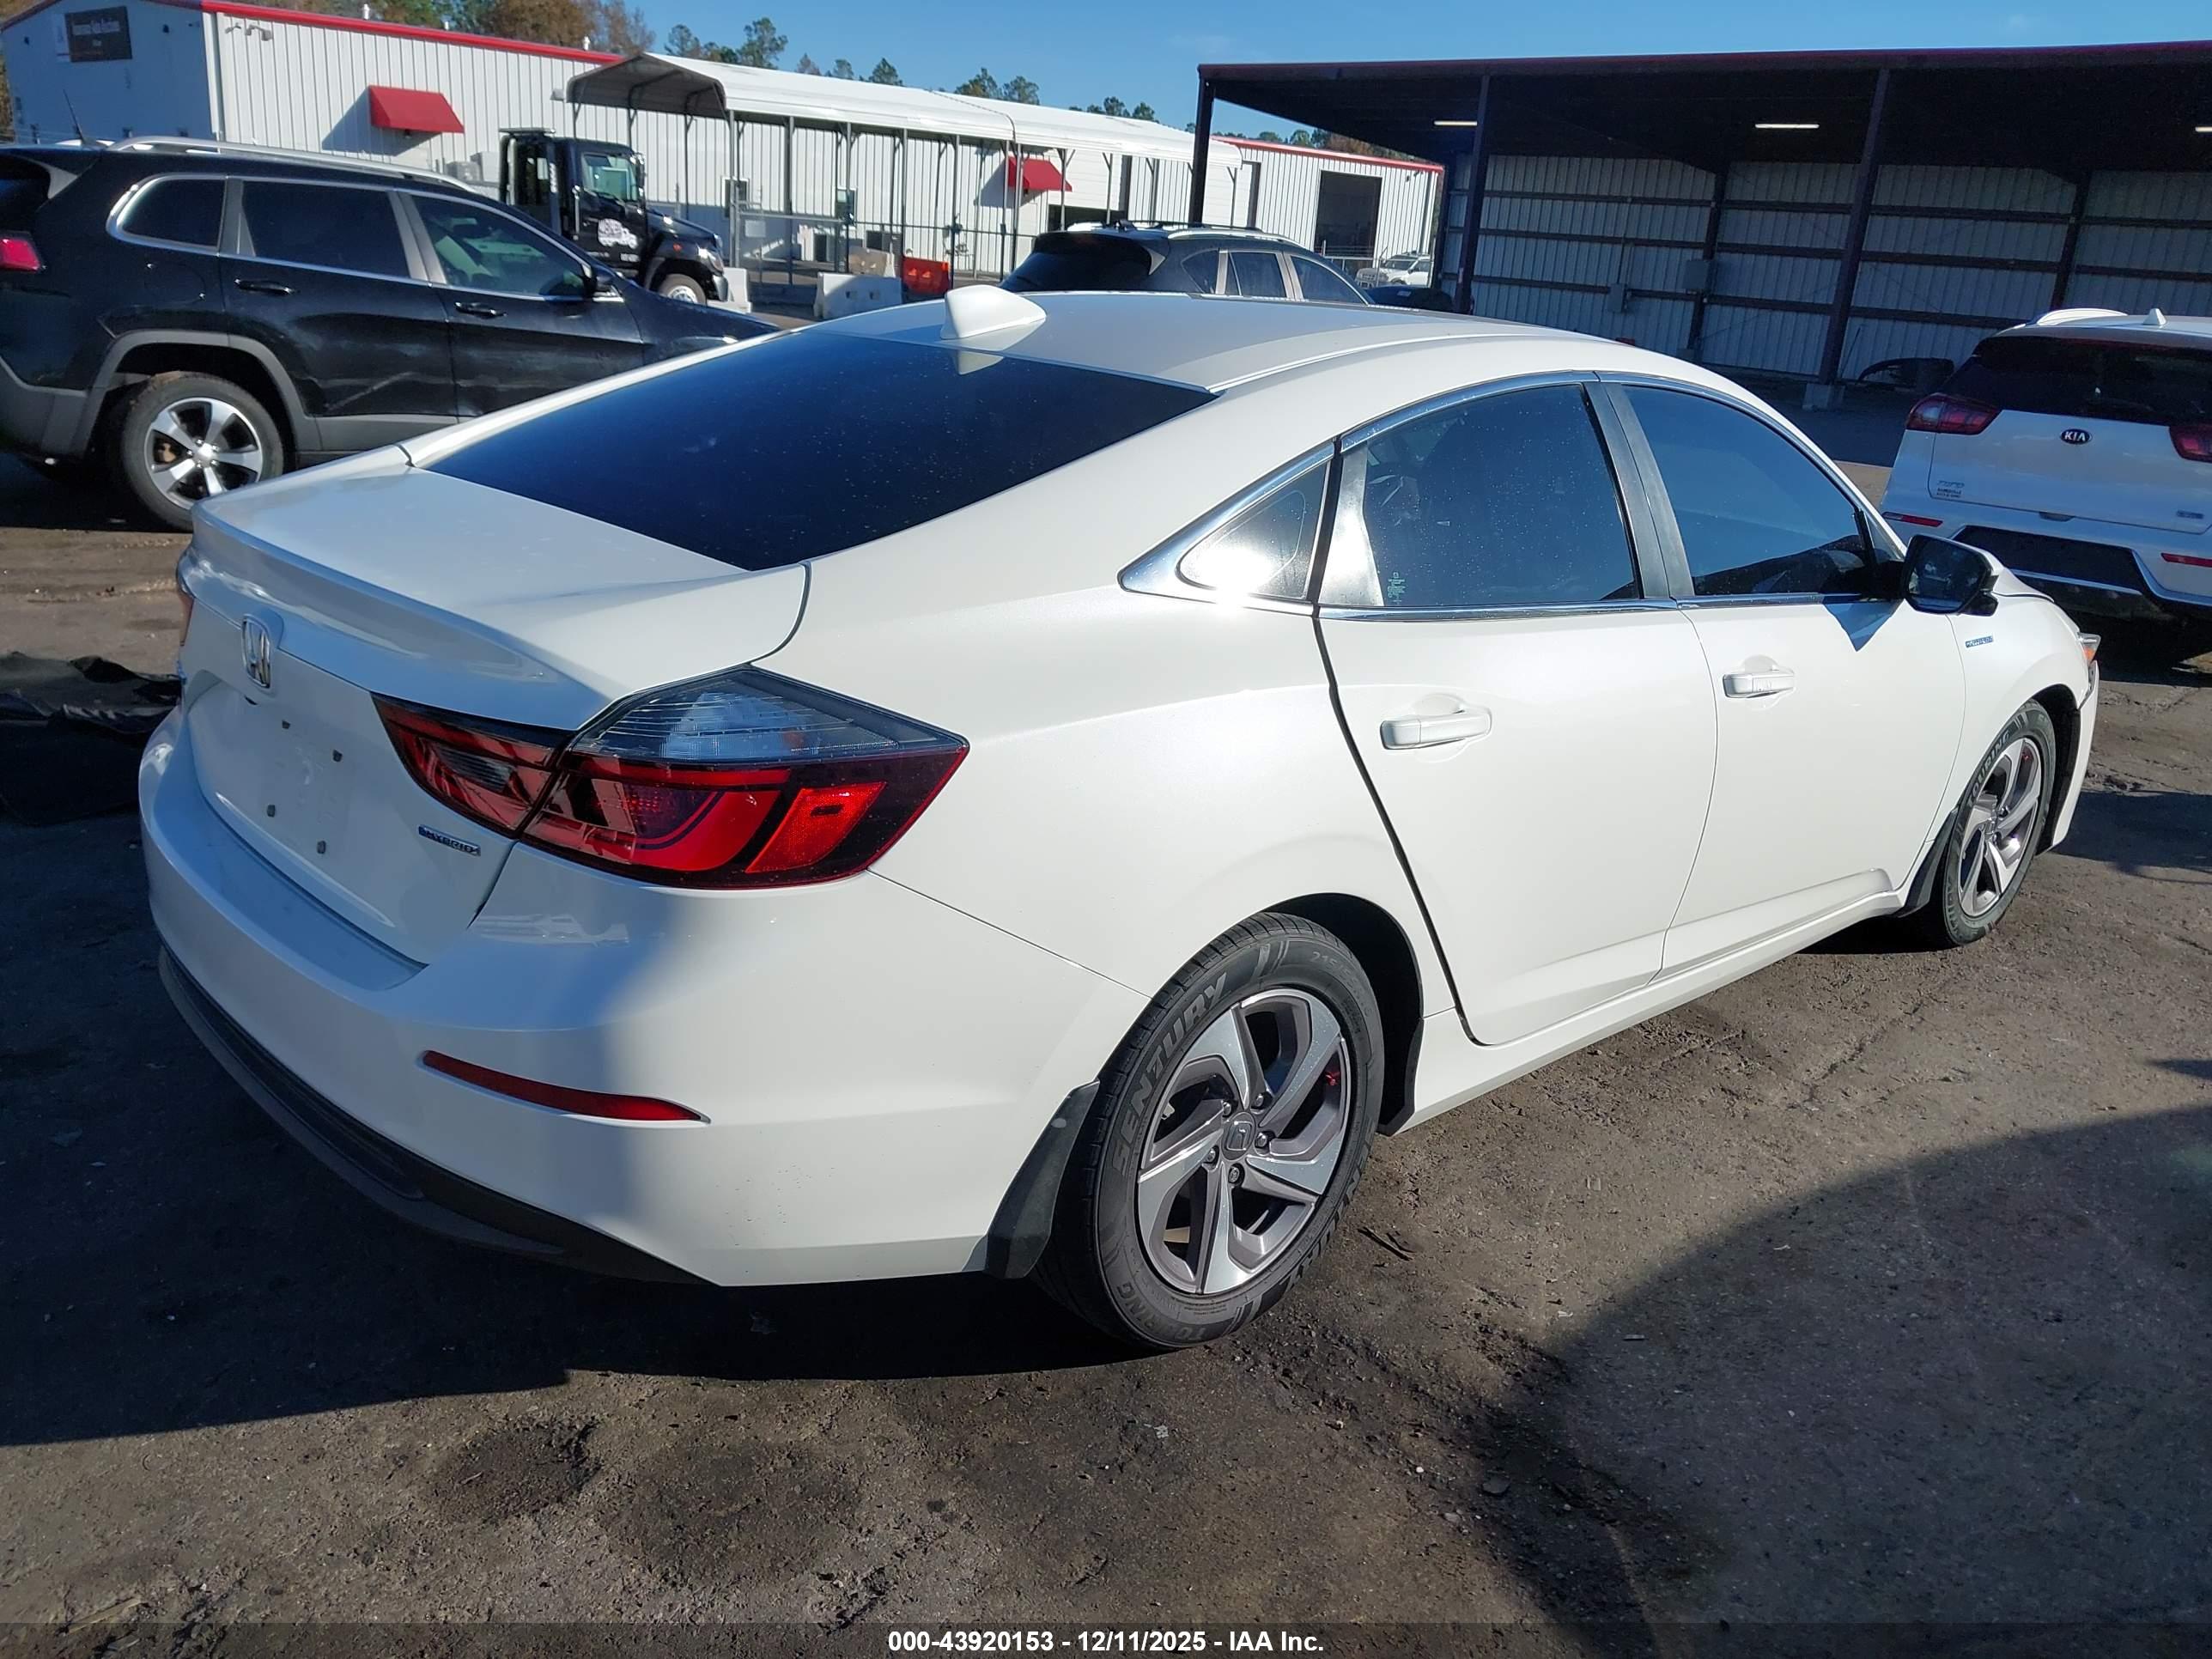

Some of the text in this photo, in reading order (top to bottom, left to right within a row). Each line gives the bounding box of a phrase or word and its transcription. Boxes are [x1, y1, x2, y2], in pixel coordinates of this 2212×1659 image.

[2063, 430, 2087, 443] KIA
[1966, 727, 2010, 808] TOURING
[423, 827, 477, 855] HYBRID
[1110, 971, 1229, 1180] SENTURY
